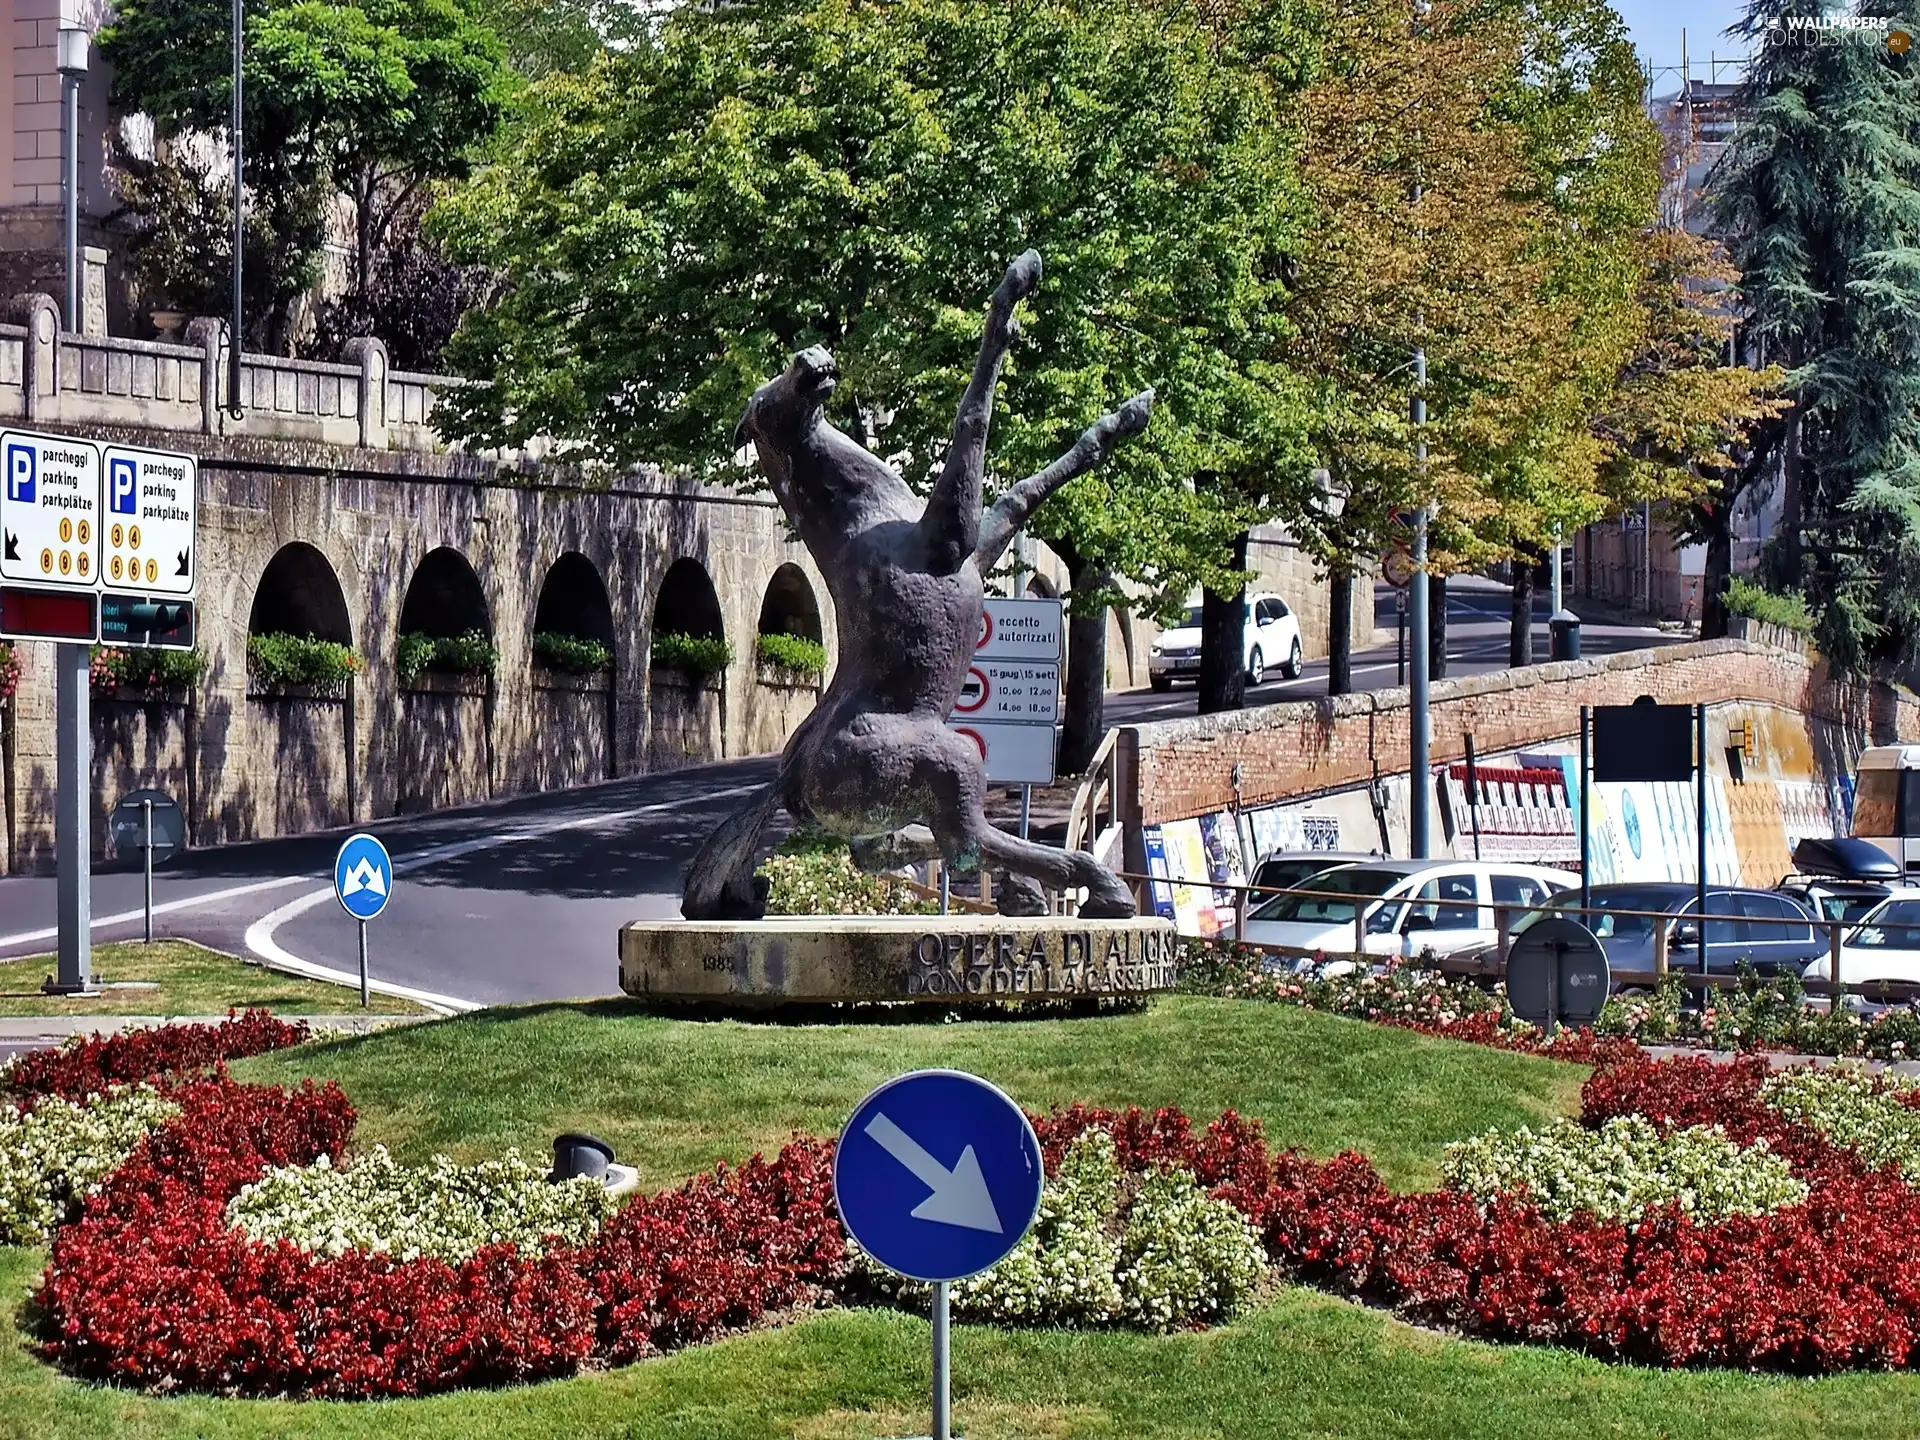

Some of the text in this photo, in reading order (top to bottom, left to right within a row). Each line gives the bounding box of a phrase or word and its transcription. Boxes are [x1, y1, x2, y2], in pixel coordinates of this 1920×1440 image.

[43, 449, 88, 468] parcheggi
[12, 449, 32, 499] P
[43, 471, 78, 489] parking
[143, 462, 186, 481] parcheggi
[114, 463, 133, 511] P
[143, 484, 176, 501] parking
[42, 493, 92, 510] parkplätze
[143, 505, 189, 521] parkplätze
[81, 524, 87, 539] 2
[114, 528, 137, 544] 3 4
[44, 553, 88, 571] 8 9 10
[114, 560, 154, 578] 5 6 7
[999, 616, 1040, 627] eccetto
[998, 631, 1055, 643] autorizzati
[990, 669, 998, 678] 15
[1035, 671, 1056, 680] sett
[916, 932, 1048, 968] OPERA
[1064, 932, 1093, 968] DI
[908, 968, 984, 994] DONO
[989, 967, 1077, 994] DELLA
[1085, 968, 1145, 993] CASSA
